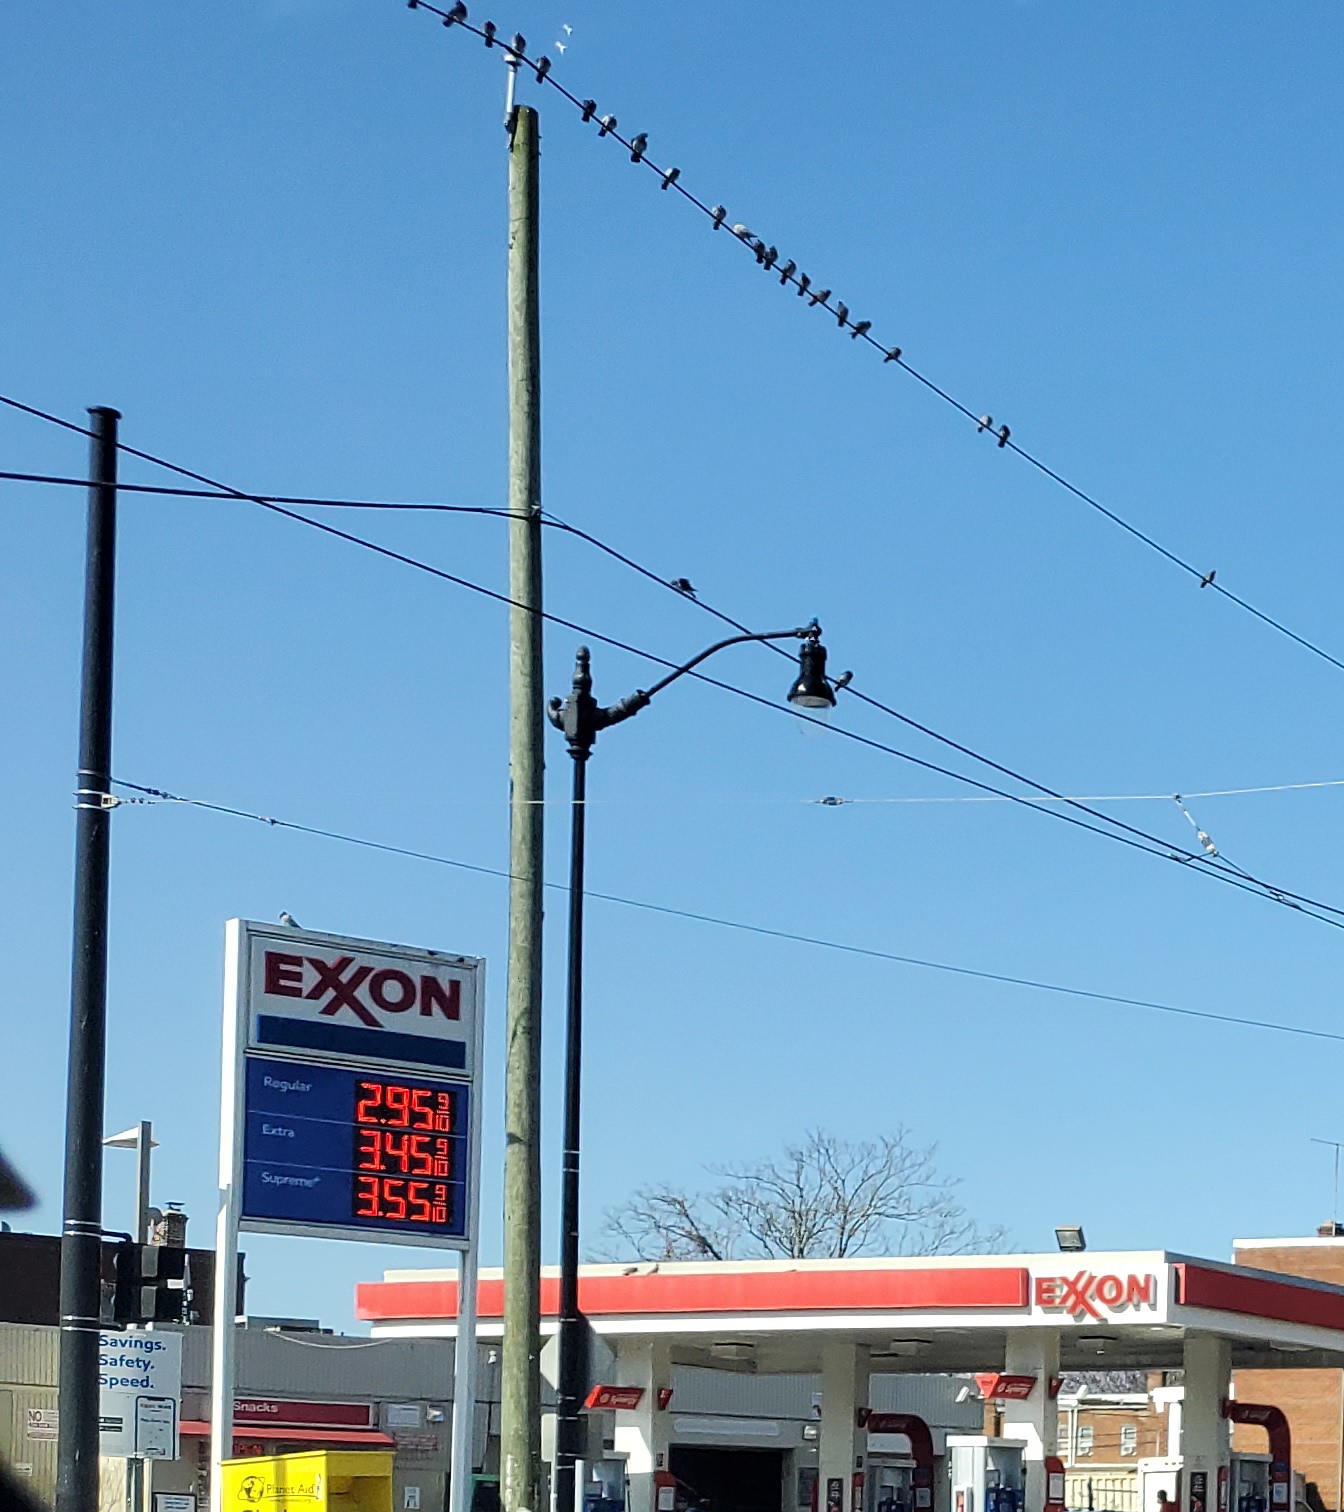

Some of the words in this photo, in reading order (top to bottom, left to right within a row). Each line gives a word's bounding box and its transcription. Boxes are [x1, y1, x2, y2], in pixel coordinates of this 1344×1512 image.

[264, 951, 461, 1028] EXXON
[263, 1076, 312, 1092] Regular
[357, 1083, 433, 1130] 2.95
[262, 1124, 295, 1138] Extra
[358, 1130, 433, 1176] 3.45
[357, 1176, 431, 1223] 3.55
[1035, 1270, 1152, 1320] EXXON
[99, 1334, 167, 1351] Savings.
[99, 1354, 155, 1372] Safety.
[99, 1373, 154, 1389] Speed.
[233, 1401, 279, 1413] Snacks
[29, 1411, 42, 1421] NO
[298, 1483, 316, 1494] Aid
